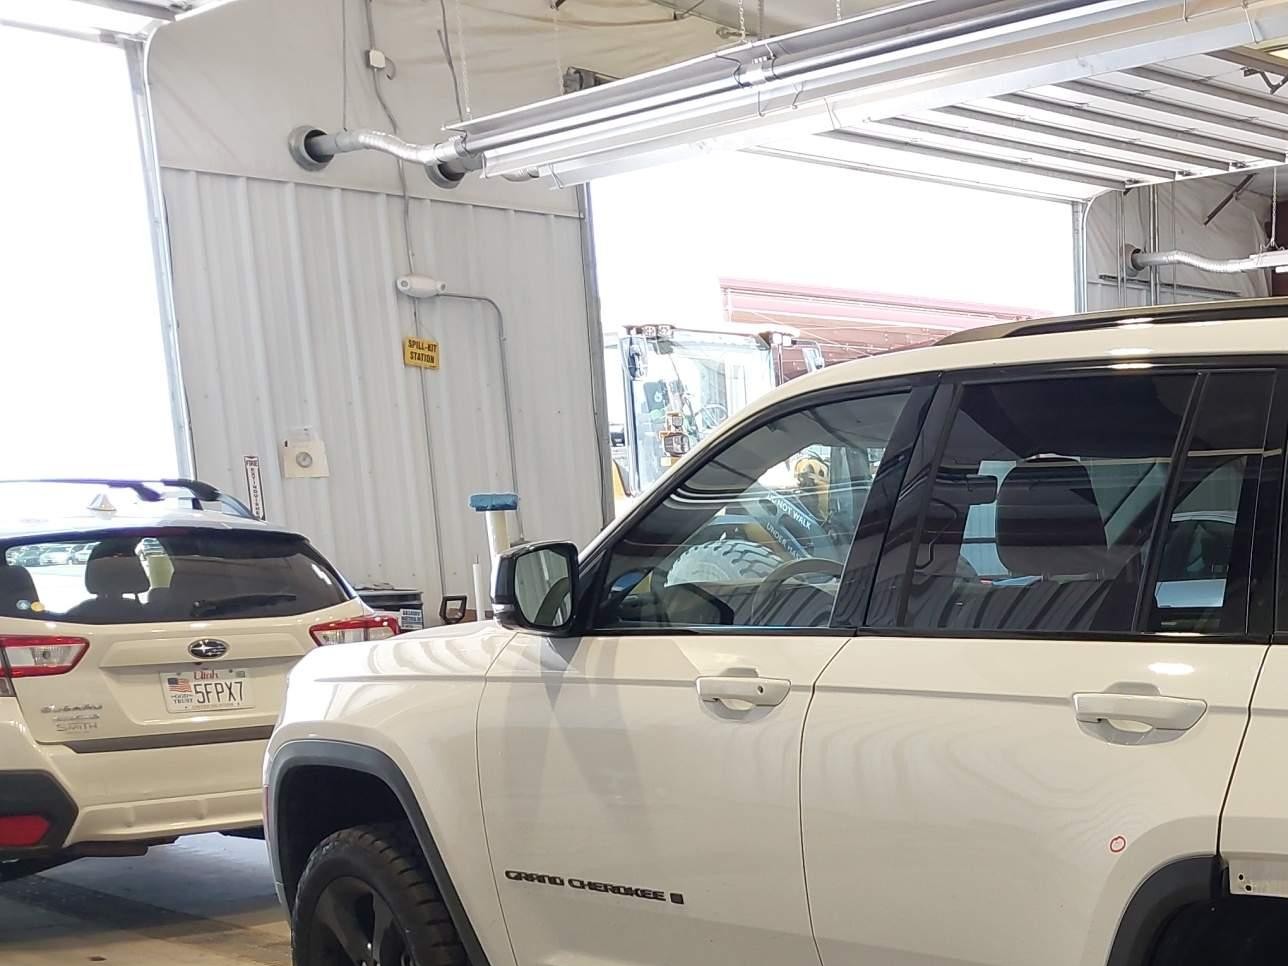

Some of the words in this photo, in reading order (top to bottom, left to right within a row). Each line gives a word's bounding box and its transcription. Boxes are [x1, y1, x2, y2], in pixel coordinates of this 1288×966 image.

[408, 339, 437, 352] SPILL-KIT
[410, 351, 434, 364] STATION
[793, 511, 812, 531] WALK
[766, 522, 788, 549] UNDER
[193, 681, 243, 704] 5FPX7
[504, 870, 565, 886] GRAND
[567, 878, 667, 902] CHEROKEE
